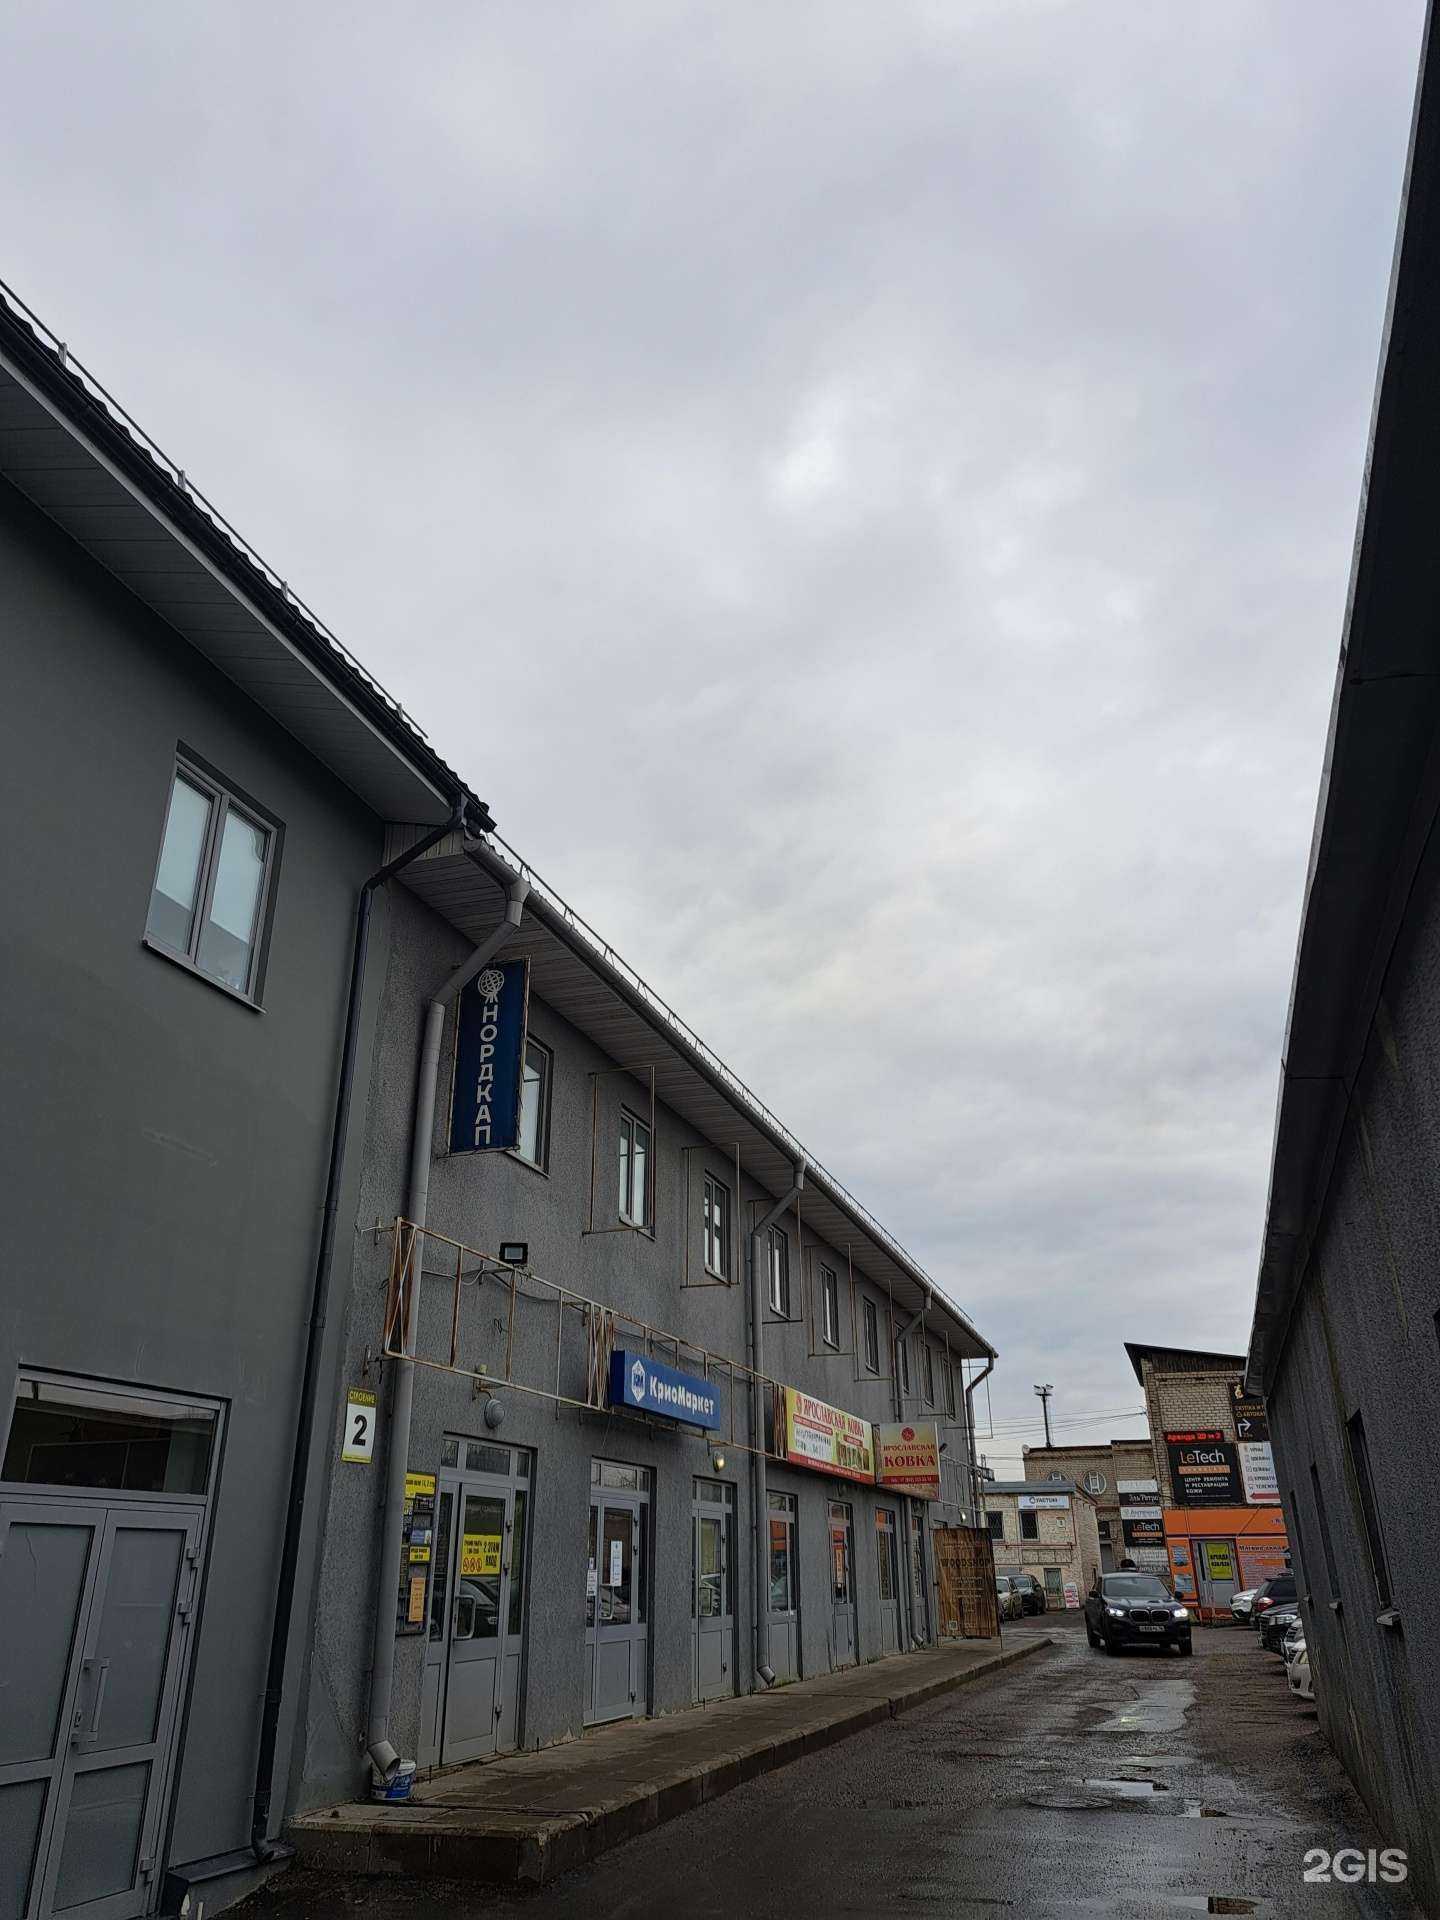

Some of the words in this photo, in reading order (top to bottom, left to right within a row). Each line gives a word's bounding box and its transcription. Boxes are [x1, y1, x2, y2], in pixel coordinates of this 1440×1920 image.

[475, 1004, 498, 1146] НОРДКАП
[649, 1375, 714, 1416] КриоМаркет
[352, 1414, 367, 1446] 2
[884, 1455, 936, 1467] КОВКА
[1179, 1448, 1225, 1464] LeTech
[1132, 1521, 1160, 1531] LeTech
[940, 1558, 991, 1567] WOODSHOP
